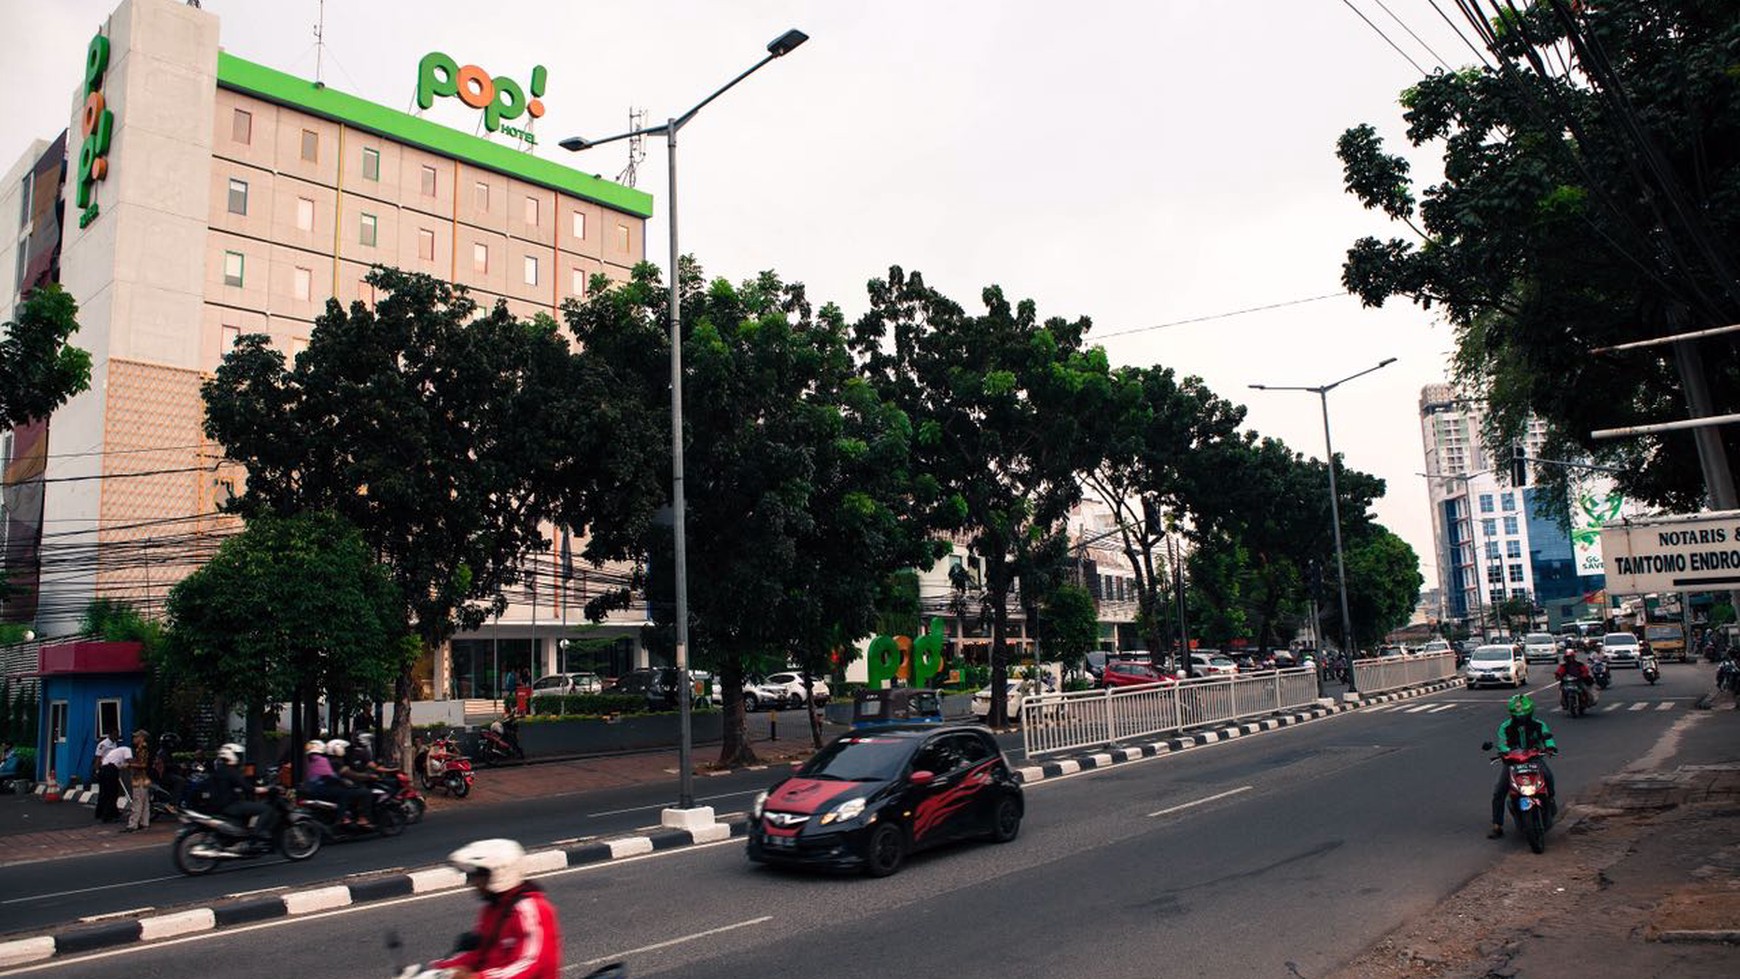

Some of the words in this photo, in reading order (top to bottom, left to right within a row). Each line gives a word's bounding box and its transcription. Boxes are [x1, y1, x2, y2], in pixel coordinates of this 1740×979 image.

[500, 123, 539, 146] HOTEL
[1659, 528, 1726, 547] NOTARIS
[1615, 553, 1686, 575] TAMTOMO
[1690, 550, 1740, 571] ENDRO
